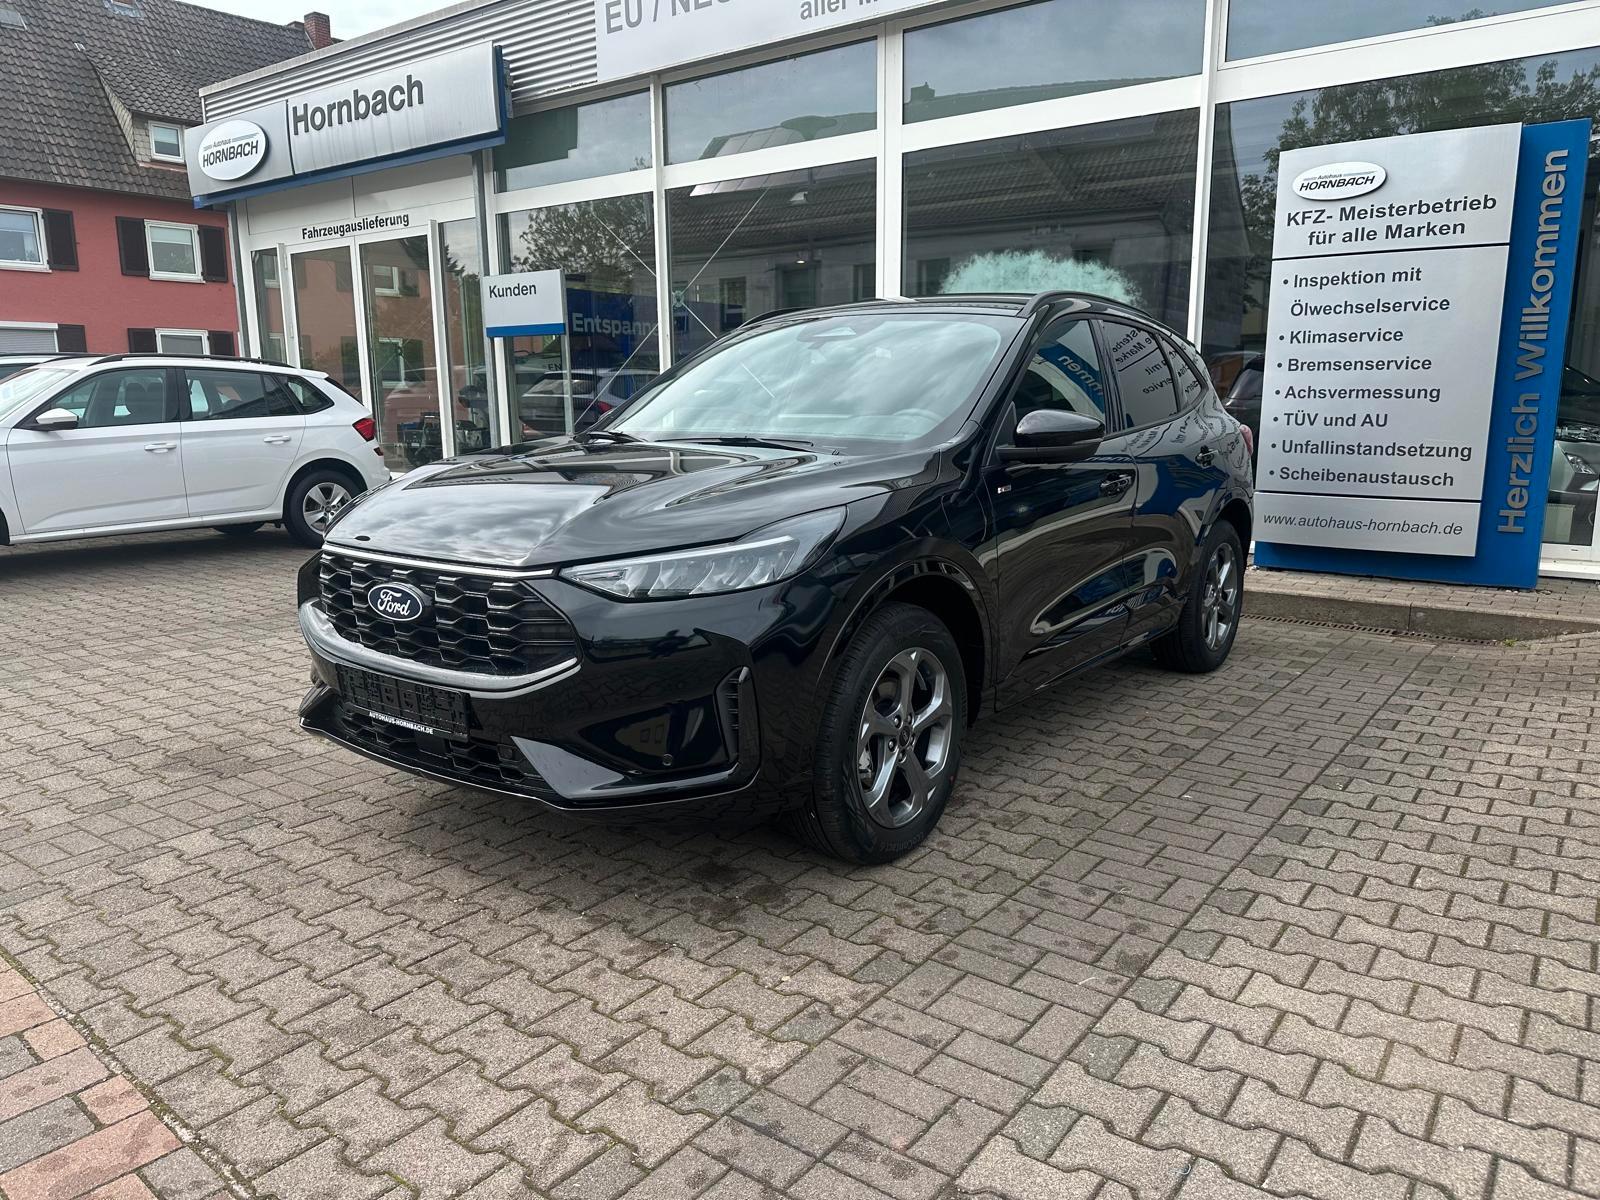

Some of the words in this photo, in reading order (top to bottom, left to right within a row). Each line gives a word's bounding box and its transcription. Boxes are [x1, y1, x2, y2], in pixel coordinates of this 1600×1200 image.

[605, 0, 643, 35] EU
[292, 74, 424, 136] Hornbach
[202, 140, 259, 168] HORNBACH
[213, 138, 232, 147] Autohaus
[1299, 175, 1376, 192] HORNBACH
[1286, 207, 1333, 227] KFZ-
[1339, 194, 1498, 222] Meisterbetrieb
[302, 213, 410, 240] Fahrzeugauslieferung
[1308, 229, 1336, 246] für
[1342, 224, 1377, 243] alle
[1385, 220, 1466, 240] Marken
[1515, 149, 1569, 381] Willkommen
[1293, 269, 1386, 290] Inspektion
[1391, 267, 1422, 283] mit
[488, 283, 538, 299] Kunden
[1290, 296, 1450, 317] Ölwechselservice
[1290, 328, 1404, 345] Klimaservice
[1287, 356, 1432, 372] Bremsenservice
[1284, 385, 1441, 402] Achsvermessung
[1283, 409, 1318, 427] TÜV
[1323, 413, 1356, 427] und
[1360, 413, 1388, 427] AU
[1281, 439, 1472, 461] Unfallinstandsetzung
[1497, 393, 1540, 534] Herzlich
[1279, 466, 1454, 487] Scheibenaustausch
[1263, 512, 1463, 536] www.autohaus-hornbach.de
[377, 589, 411, 616] Ford
[368, 711, 434, 735] AUTOHAUS-HORNBACH.DE
